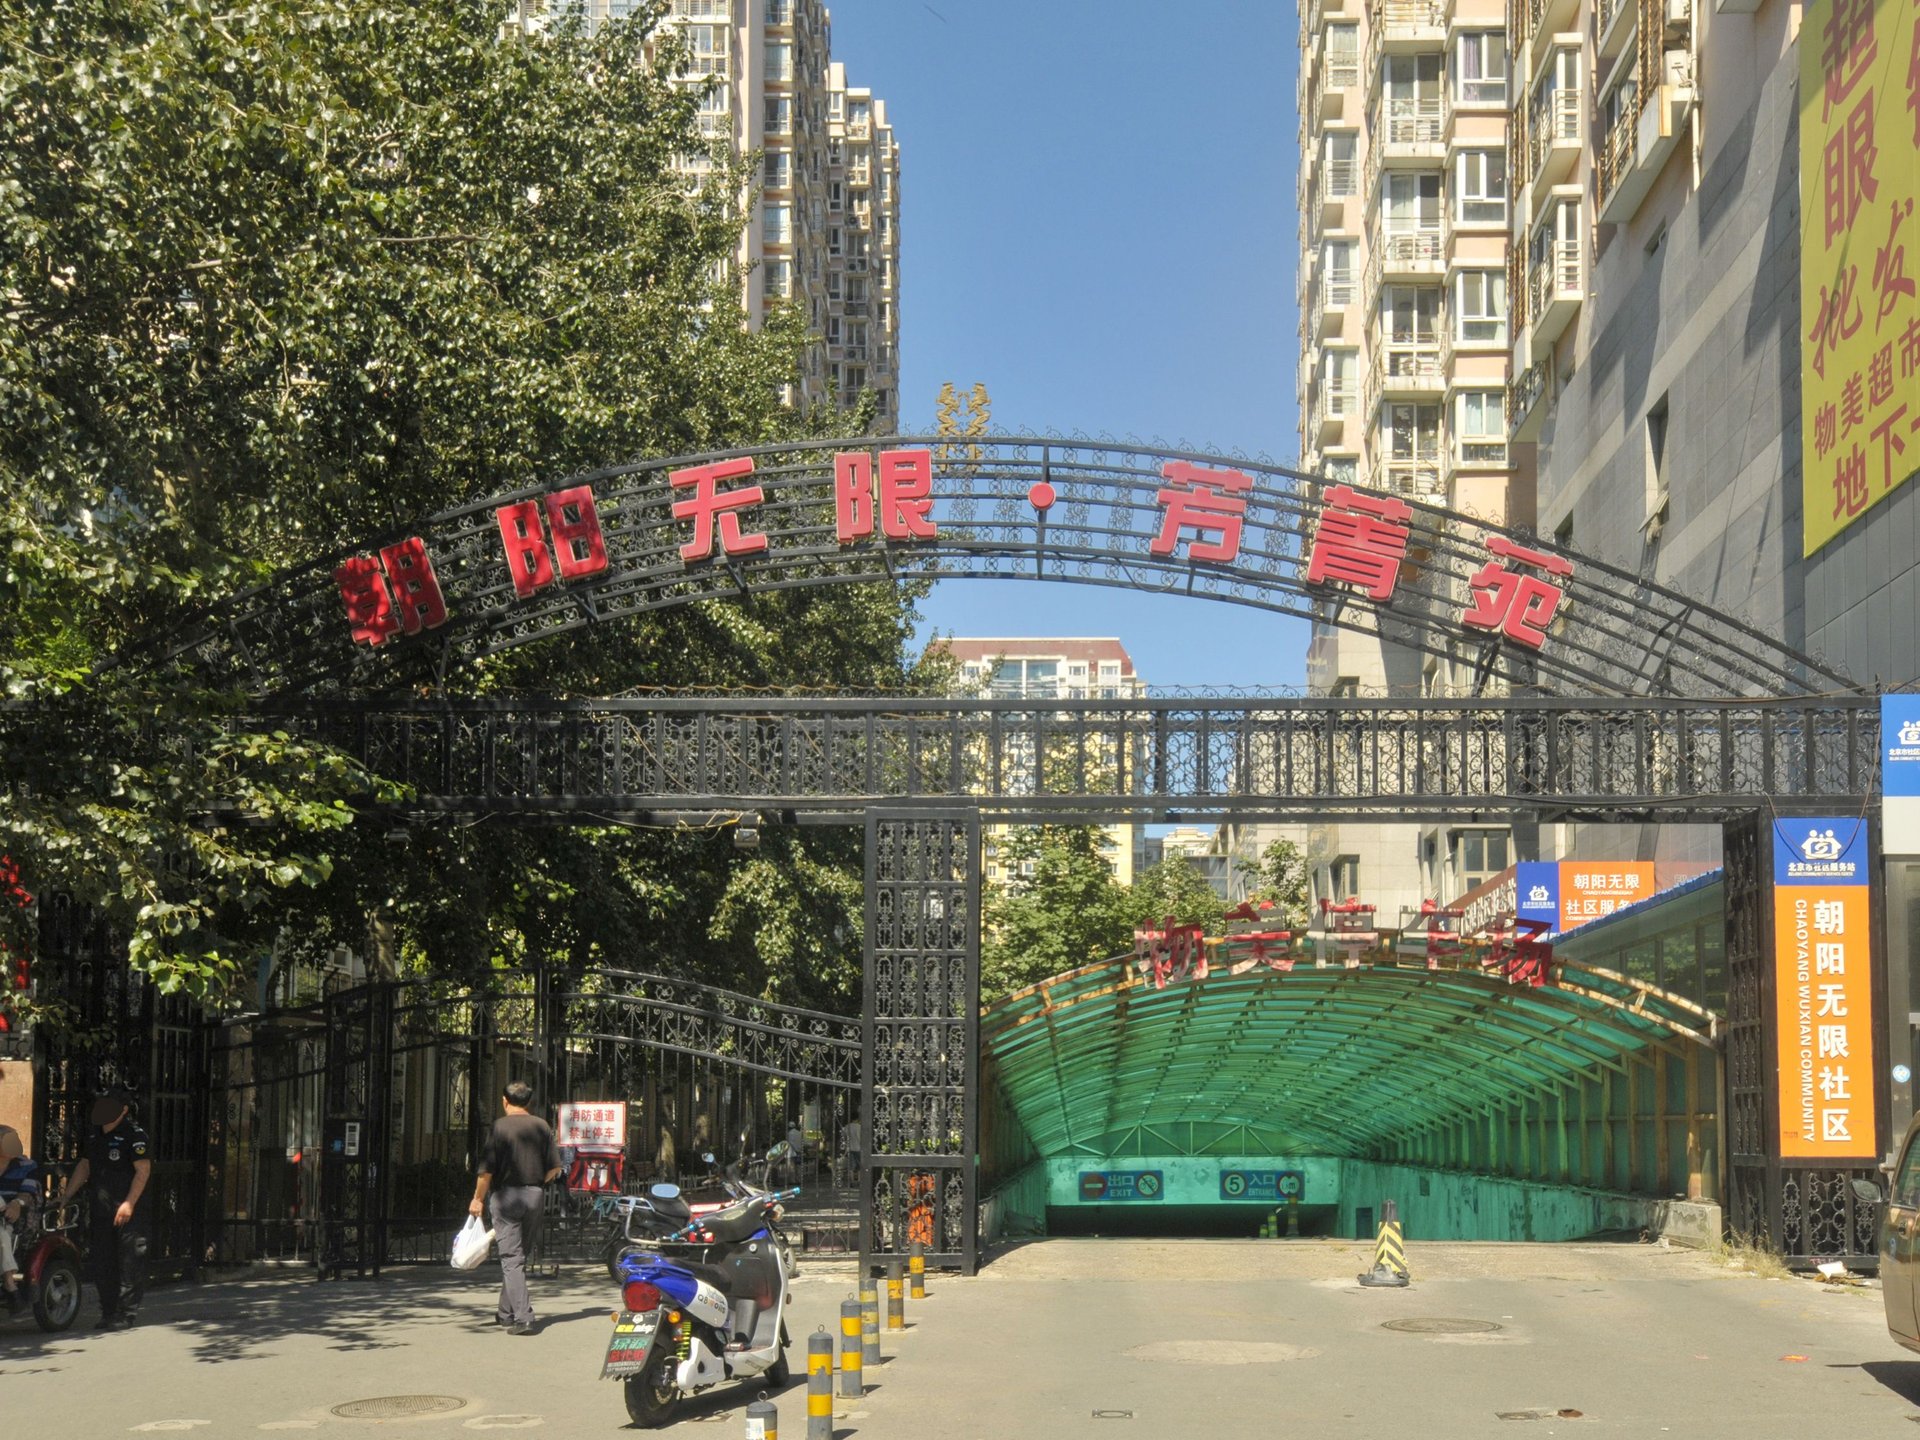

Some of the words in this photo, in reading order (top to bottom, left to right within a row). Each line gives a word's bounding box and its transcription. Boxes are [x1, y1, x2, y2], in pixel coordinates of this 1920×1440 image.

[1808, 197, 1916, 382] 批发
[1813, 316, 1920, 462] 物美超市
[1832, 402, 1920, 521] 地下
[334, 448, 938, 647] 朝阳无限
[1149, 460, 1574, 650] 芳菁苑
[1573, 874, 1640, 889] 朝阳无限
[1795, 899, 1810, 982] CHAOYANG
[1798, 984, 1812, 1046] WUXIAN
[1812, 899, 1852, 1141] 朝阳无限社区
[569, 1109, 615, 1122] 消防通道
[1801, 1048, 1815, 1143] COMMUNITY
[569, 1127, 615, 1139] 禁止停车
[1108, 1175, 1134, 1187] 出口
[1110, 1189, 1132, 1197] EXIT
[1229, 1177, 1240, 1192] 5
[1249, 1174, 1275, 1186] 入口
